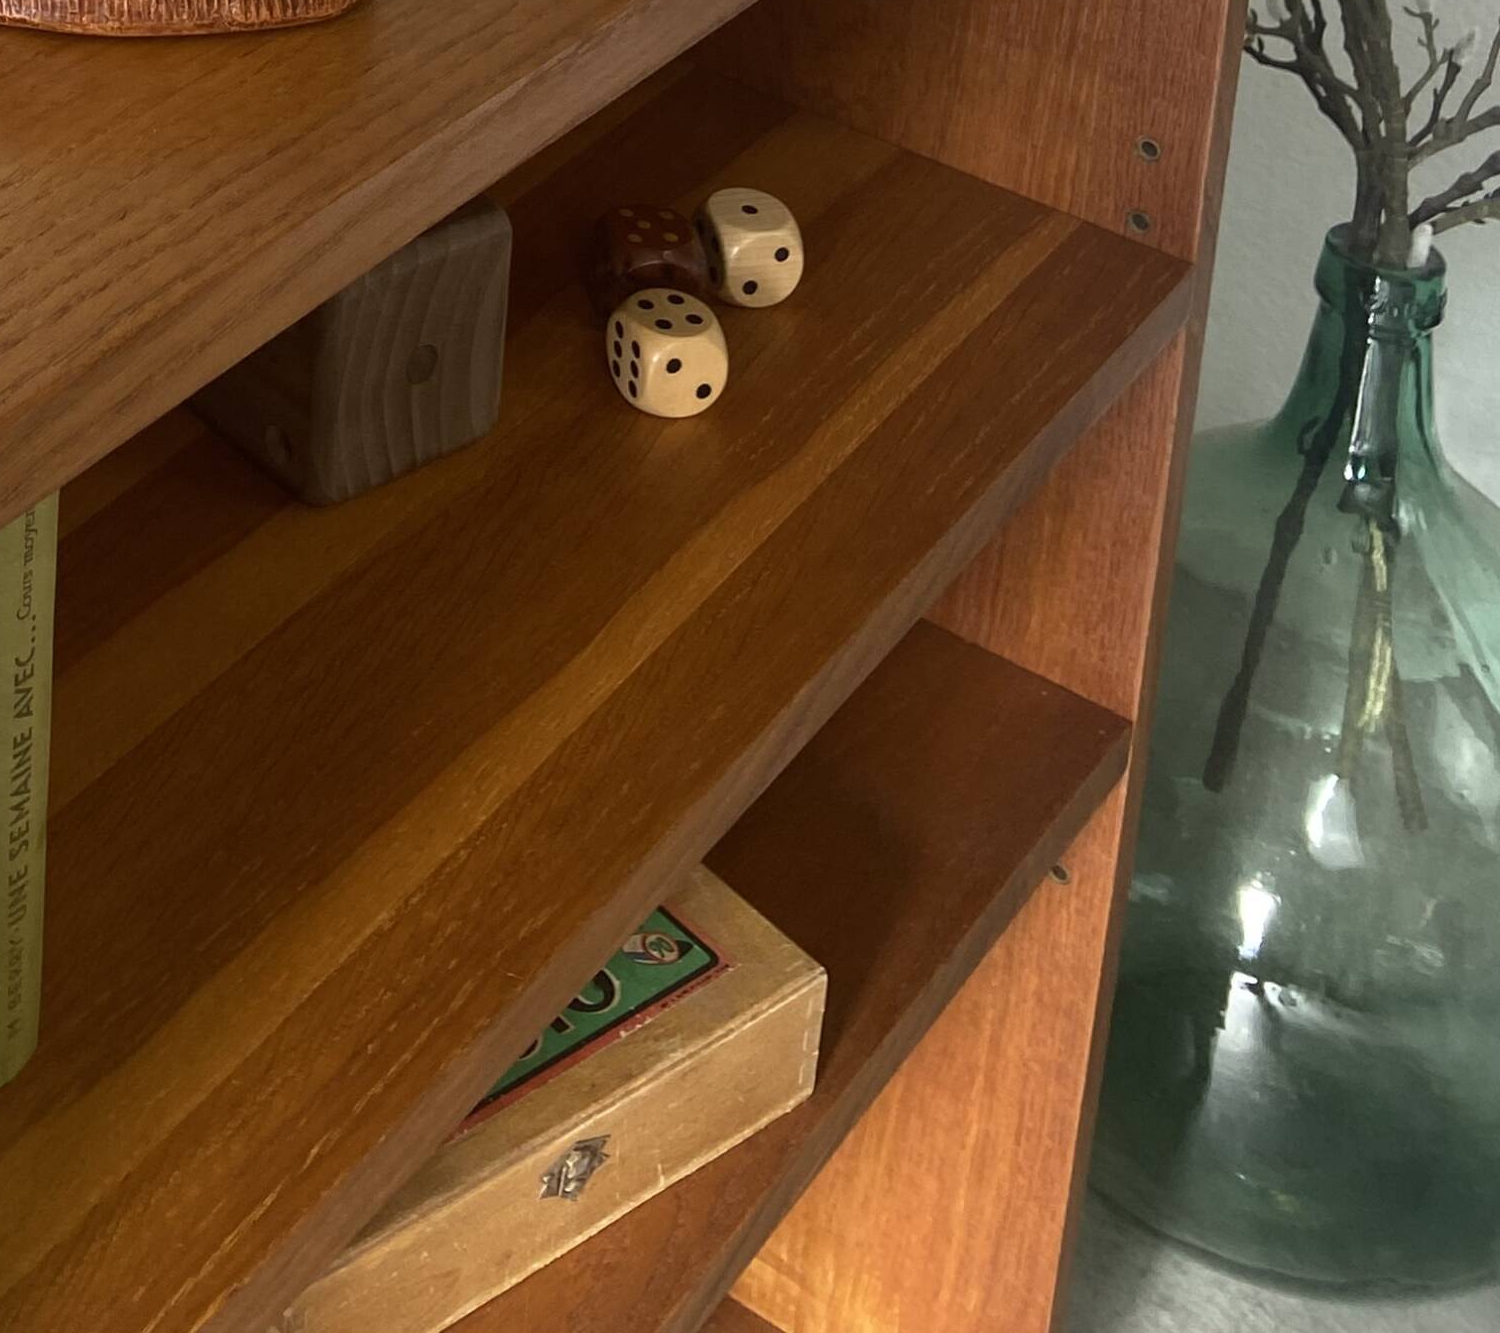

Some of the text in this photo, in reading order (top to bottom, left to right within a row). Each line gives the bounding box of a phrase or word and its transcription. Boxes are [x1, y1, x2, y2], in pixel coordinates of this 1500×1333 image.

[16, 569, 34, 621] Cours
[8, 726, 34, 862] SEMAINE
[7, 864, 29, 928] UNE
